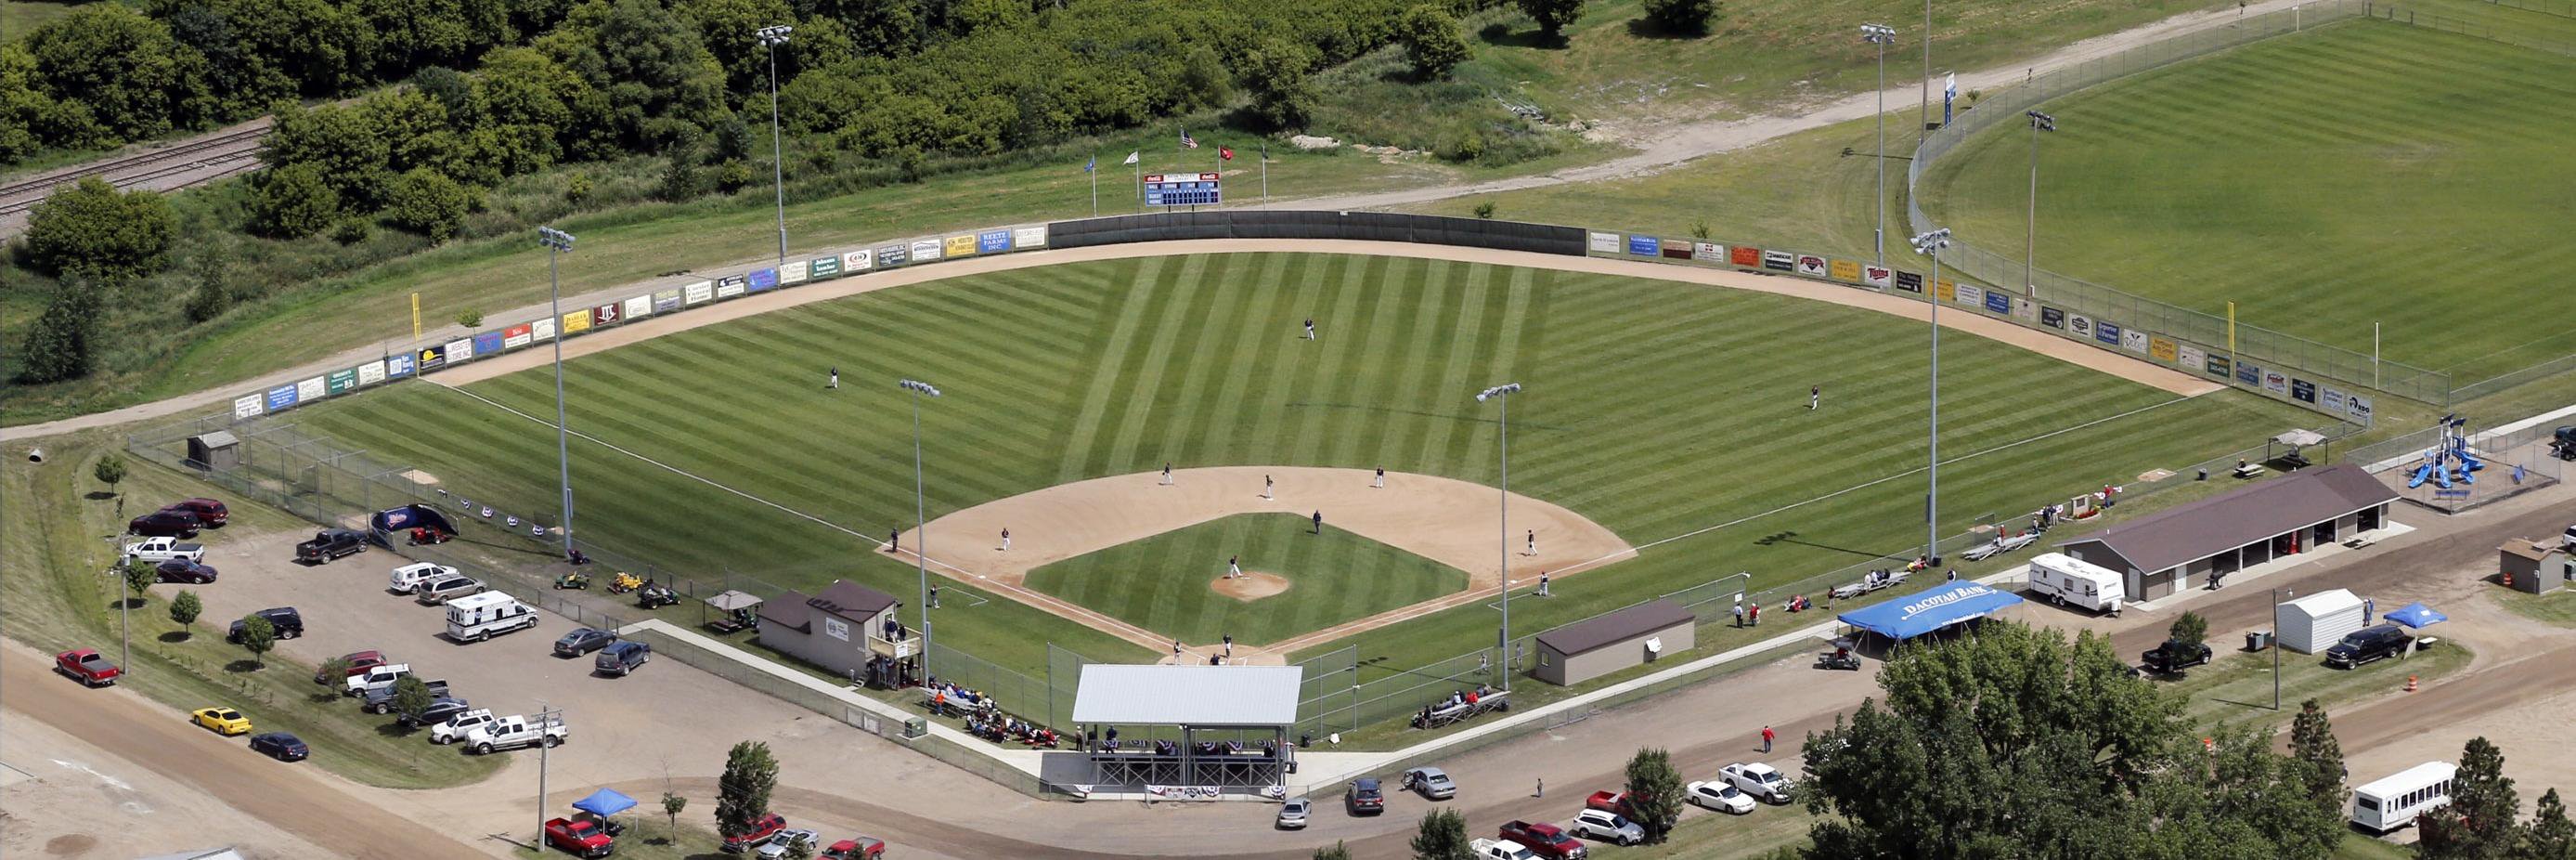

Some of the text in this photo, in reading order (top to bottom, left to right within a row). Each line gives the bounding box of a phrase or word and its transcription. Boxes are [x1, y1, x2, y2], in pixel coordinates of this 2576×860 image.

[983, 232, 1006, 241] REETZ
[1868, 267, 1889, 279] Twins
[1904, 585, 1987, 614] DACOTAH BANK
